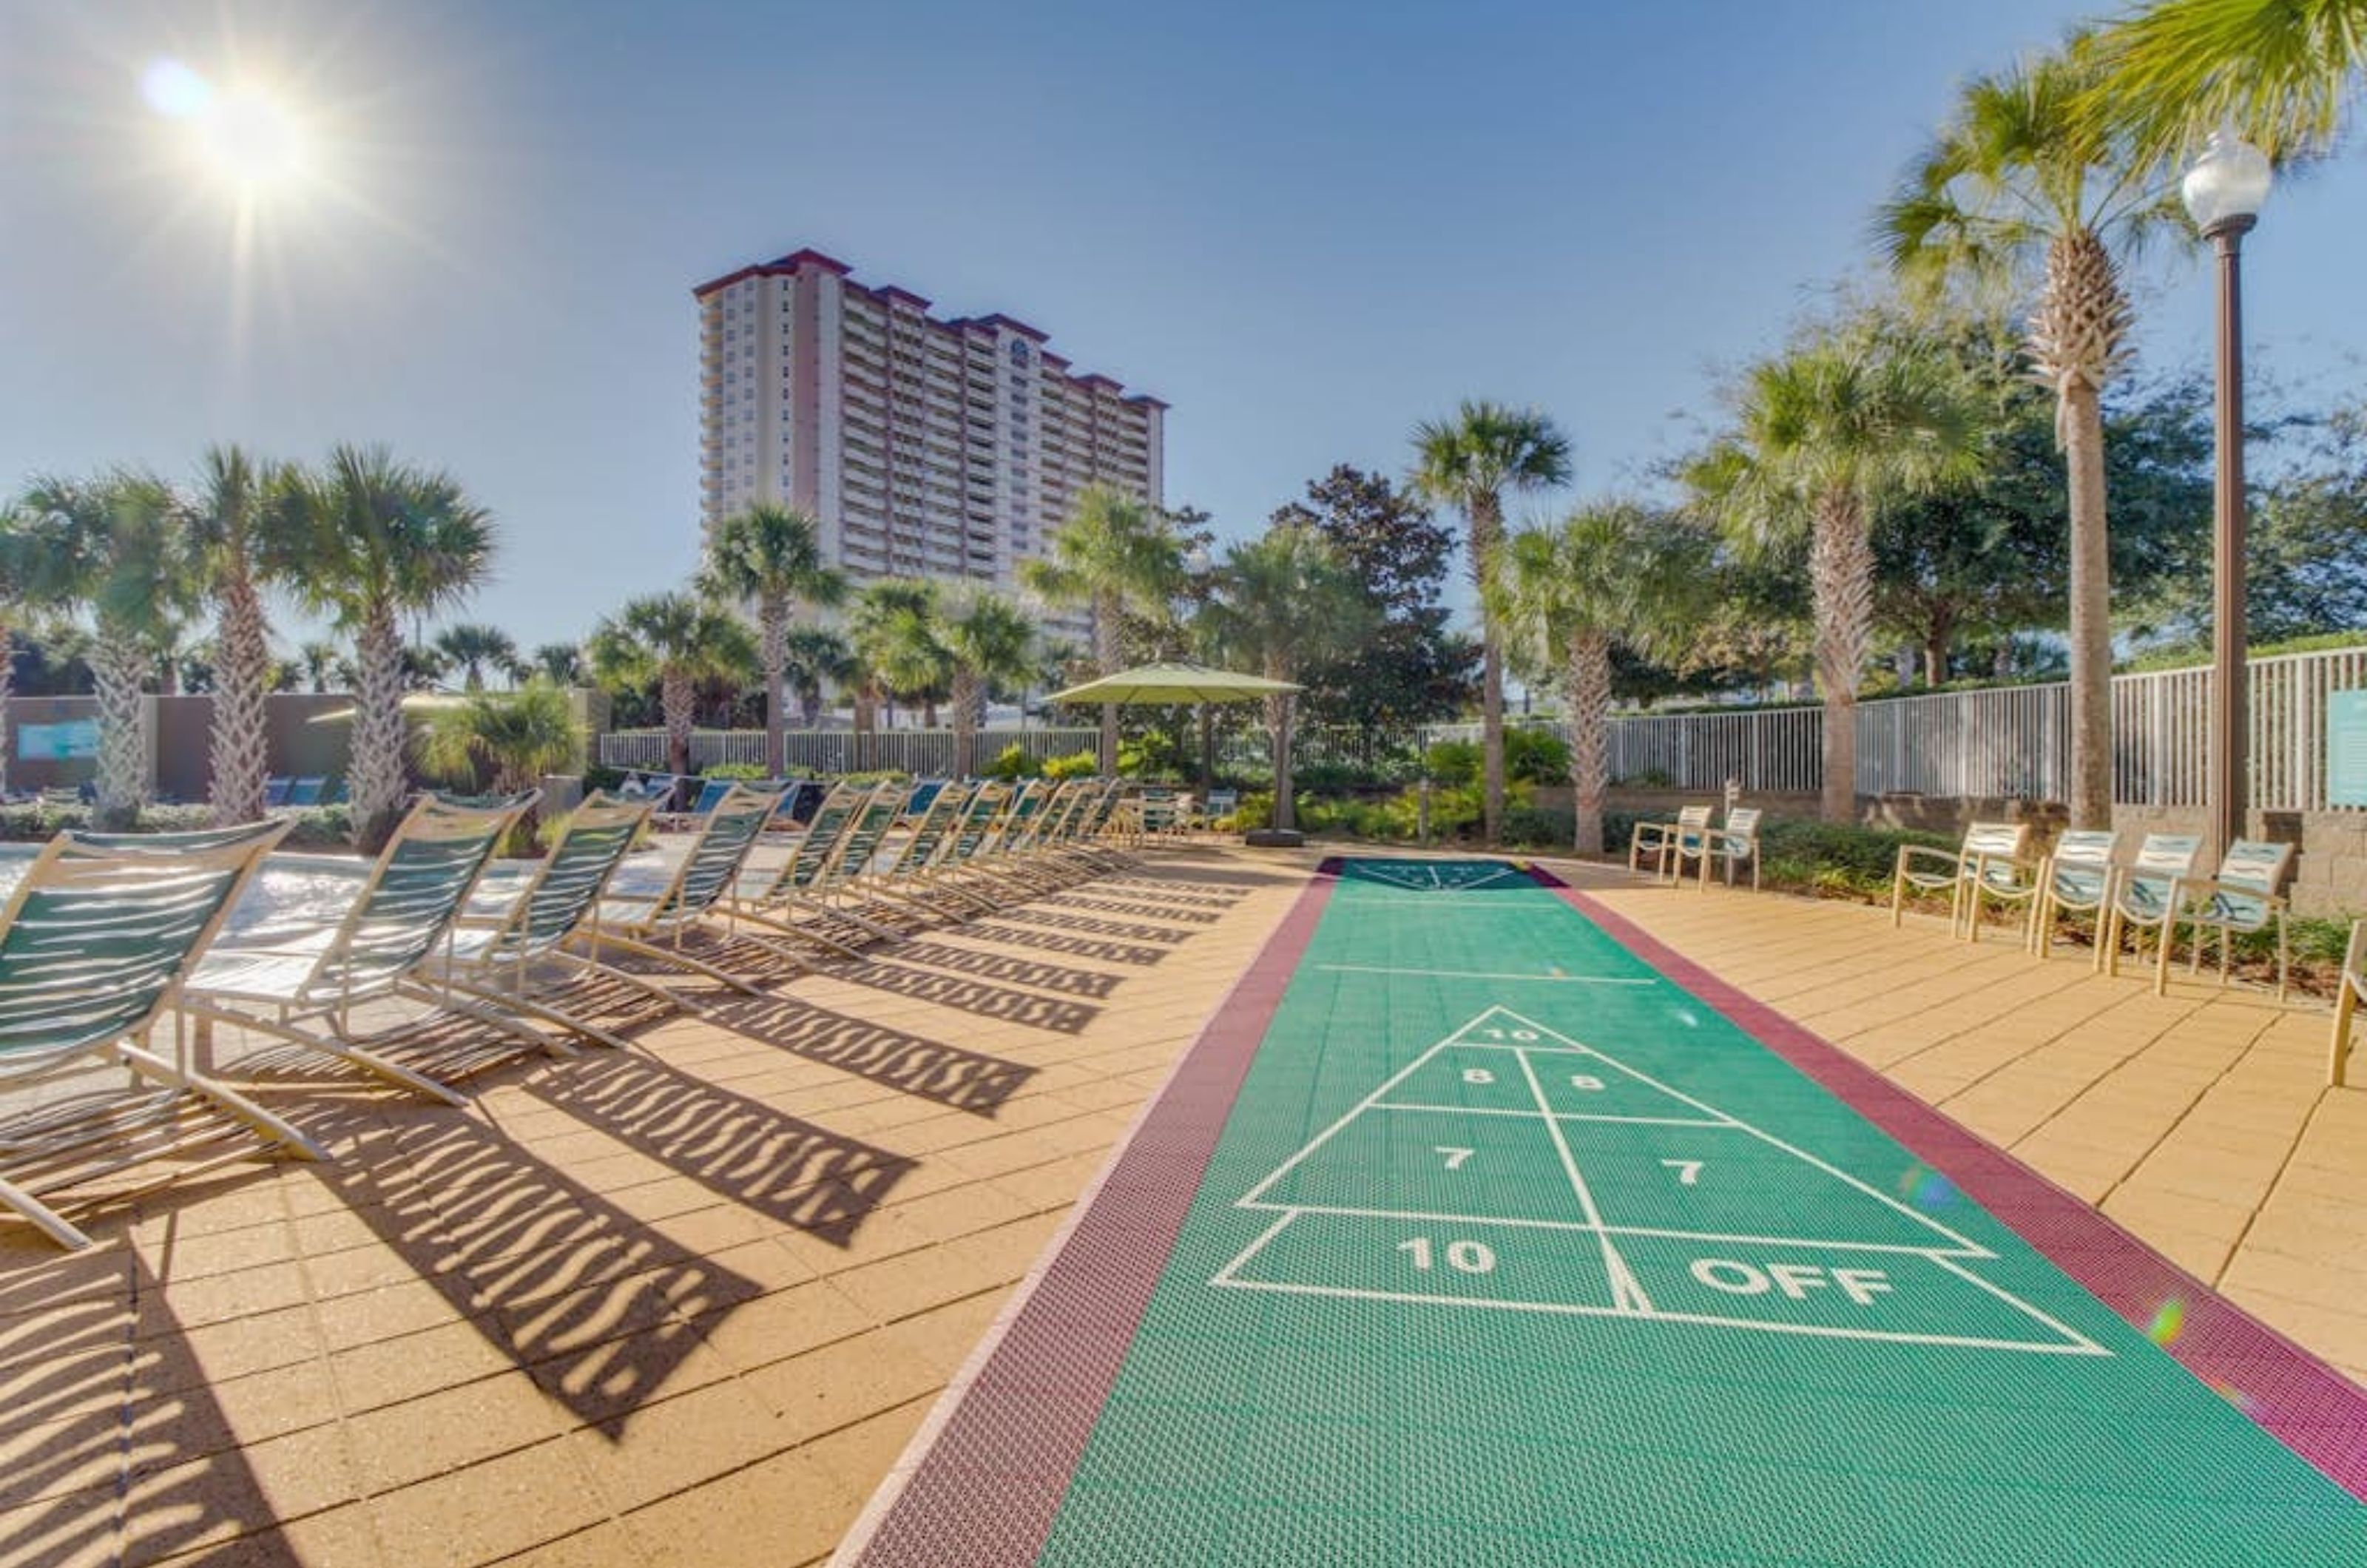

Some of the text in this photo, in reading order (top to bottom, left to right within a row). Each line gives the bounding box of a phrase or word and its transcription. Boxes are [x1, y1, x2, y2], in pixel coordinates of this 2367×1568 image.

[1462, 1068, 1495, 1084] 8
[1571, 1075, 1605, 1090] 8
[1434, 1146, 1474, 1170] 7
[1661, 1159, 1704, 1186] 7
[1397, 1237, 1894, 1305] 10 OFF
